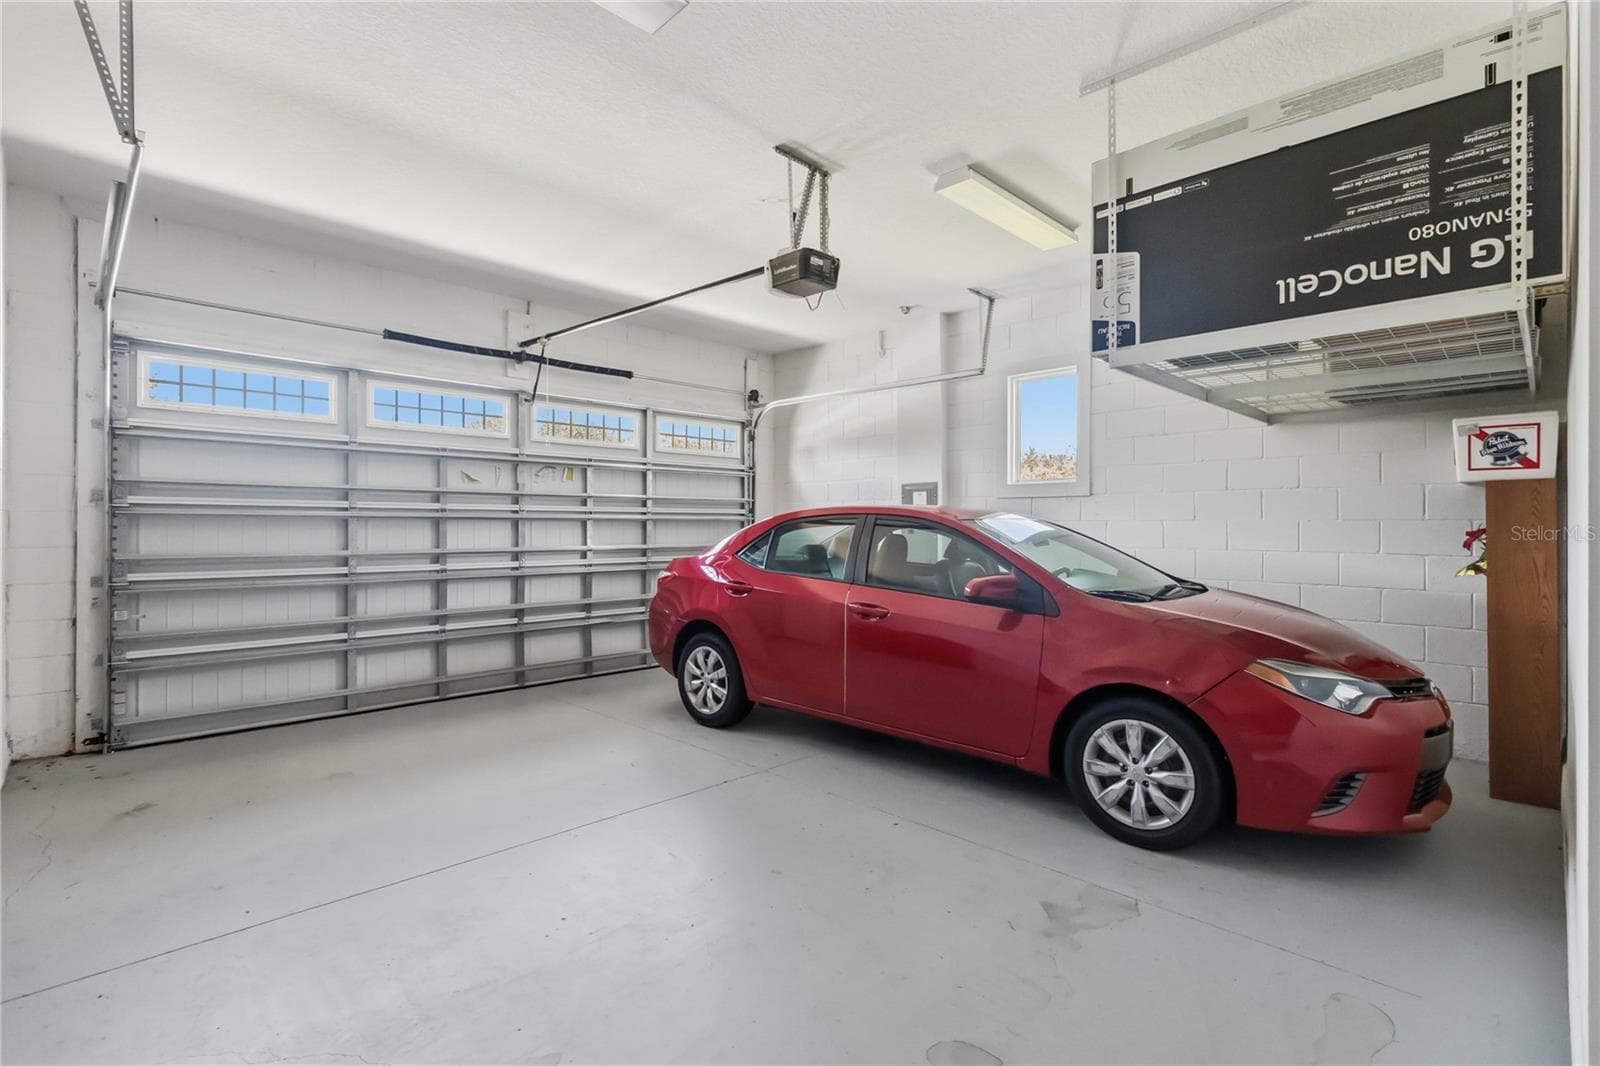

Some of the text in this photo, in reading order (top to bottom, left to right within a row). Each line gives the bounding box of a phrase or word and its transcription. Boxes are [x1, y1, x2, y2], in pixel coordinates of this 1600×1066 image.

[1462, 130, 1499, 144] Gameplay
[1445, 149, 1484, 164] Experience
[1494, 172, 1510, 181] Core
[1453, 200, 1464, 208] 4K
[1464, 197, 1480, 206] Real
[1276, 230, 1533, 304] LG NanoCell
[1098, 323, 1130, 334] NOAU
